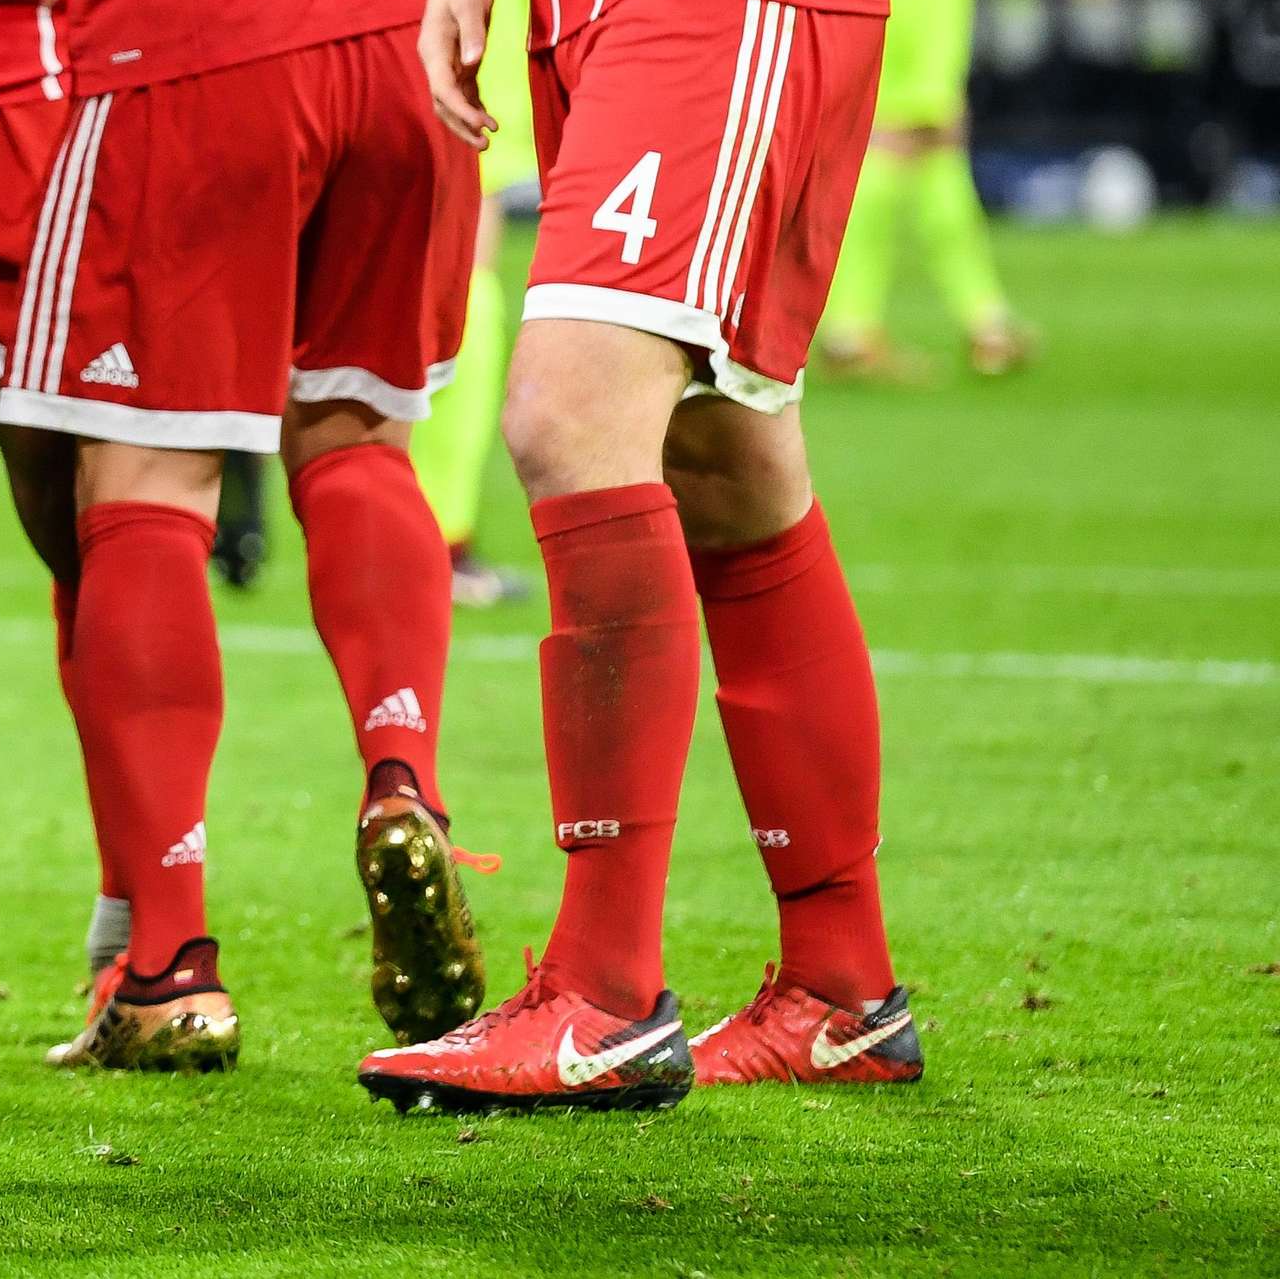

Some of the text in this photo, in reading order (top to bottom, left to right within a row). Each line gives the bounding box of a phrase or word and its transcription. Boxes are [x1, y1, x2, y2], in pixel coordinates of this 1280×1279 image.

[591, 150, 663, 266] 4
[79, 367, 140, 389] adidas
[558, 819, 621, 841] FCB
